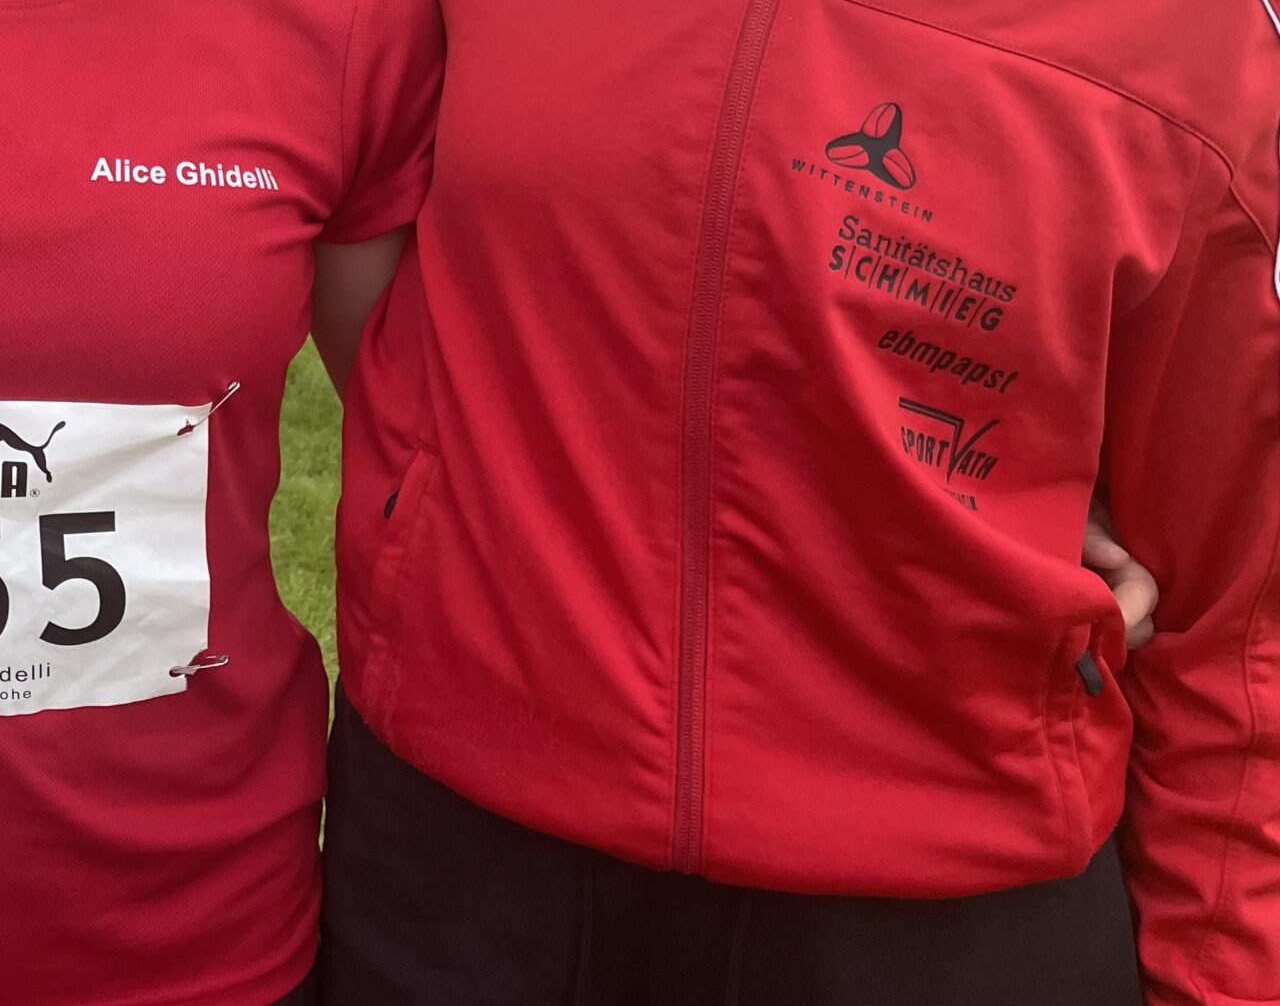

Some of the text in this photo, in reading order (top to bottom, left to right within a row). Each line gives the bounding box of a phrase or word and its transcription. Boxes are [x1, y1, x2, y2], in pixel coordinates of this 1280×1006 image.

[90, 157, 279, 191] Alice Ghidelli
[791, 157, 934, 223] WITTENSTEIN
[838, 214, 1017, 304] Sanitätshaus
[877, 329, 1019, 394] ebmpapst
